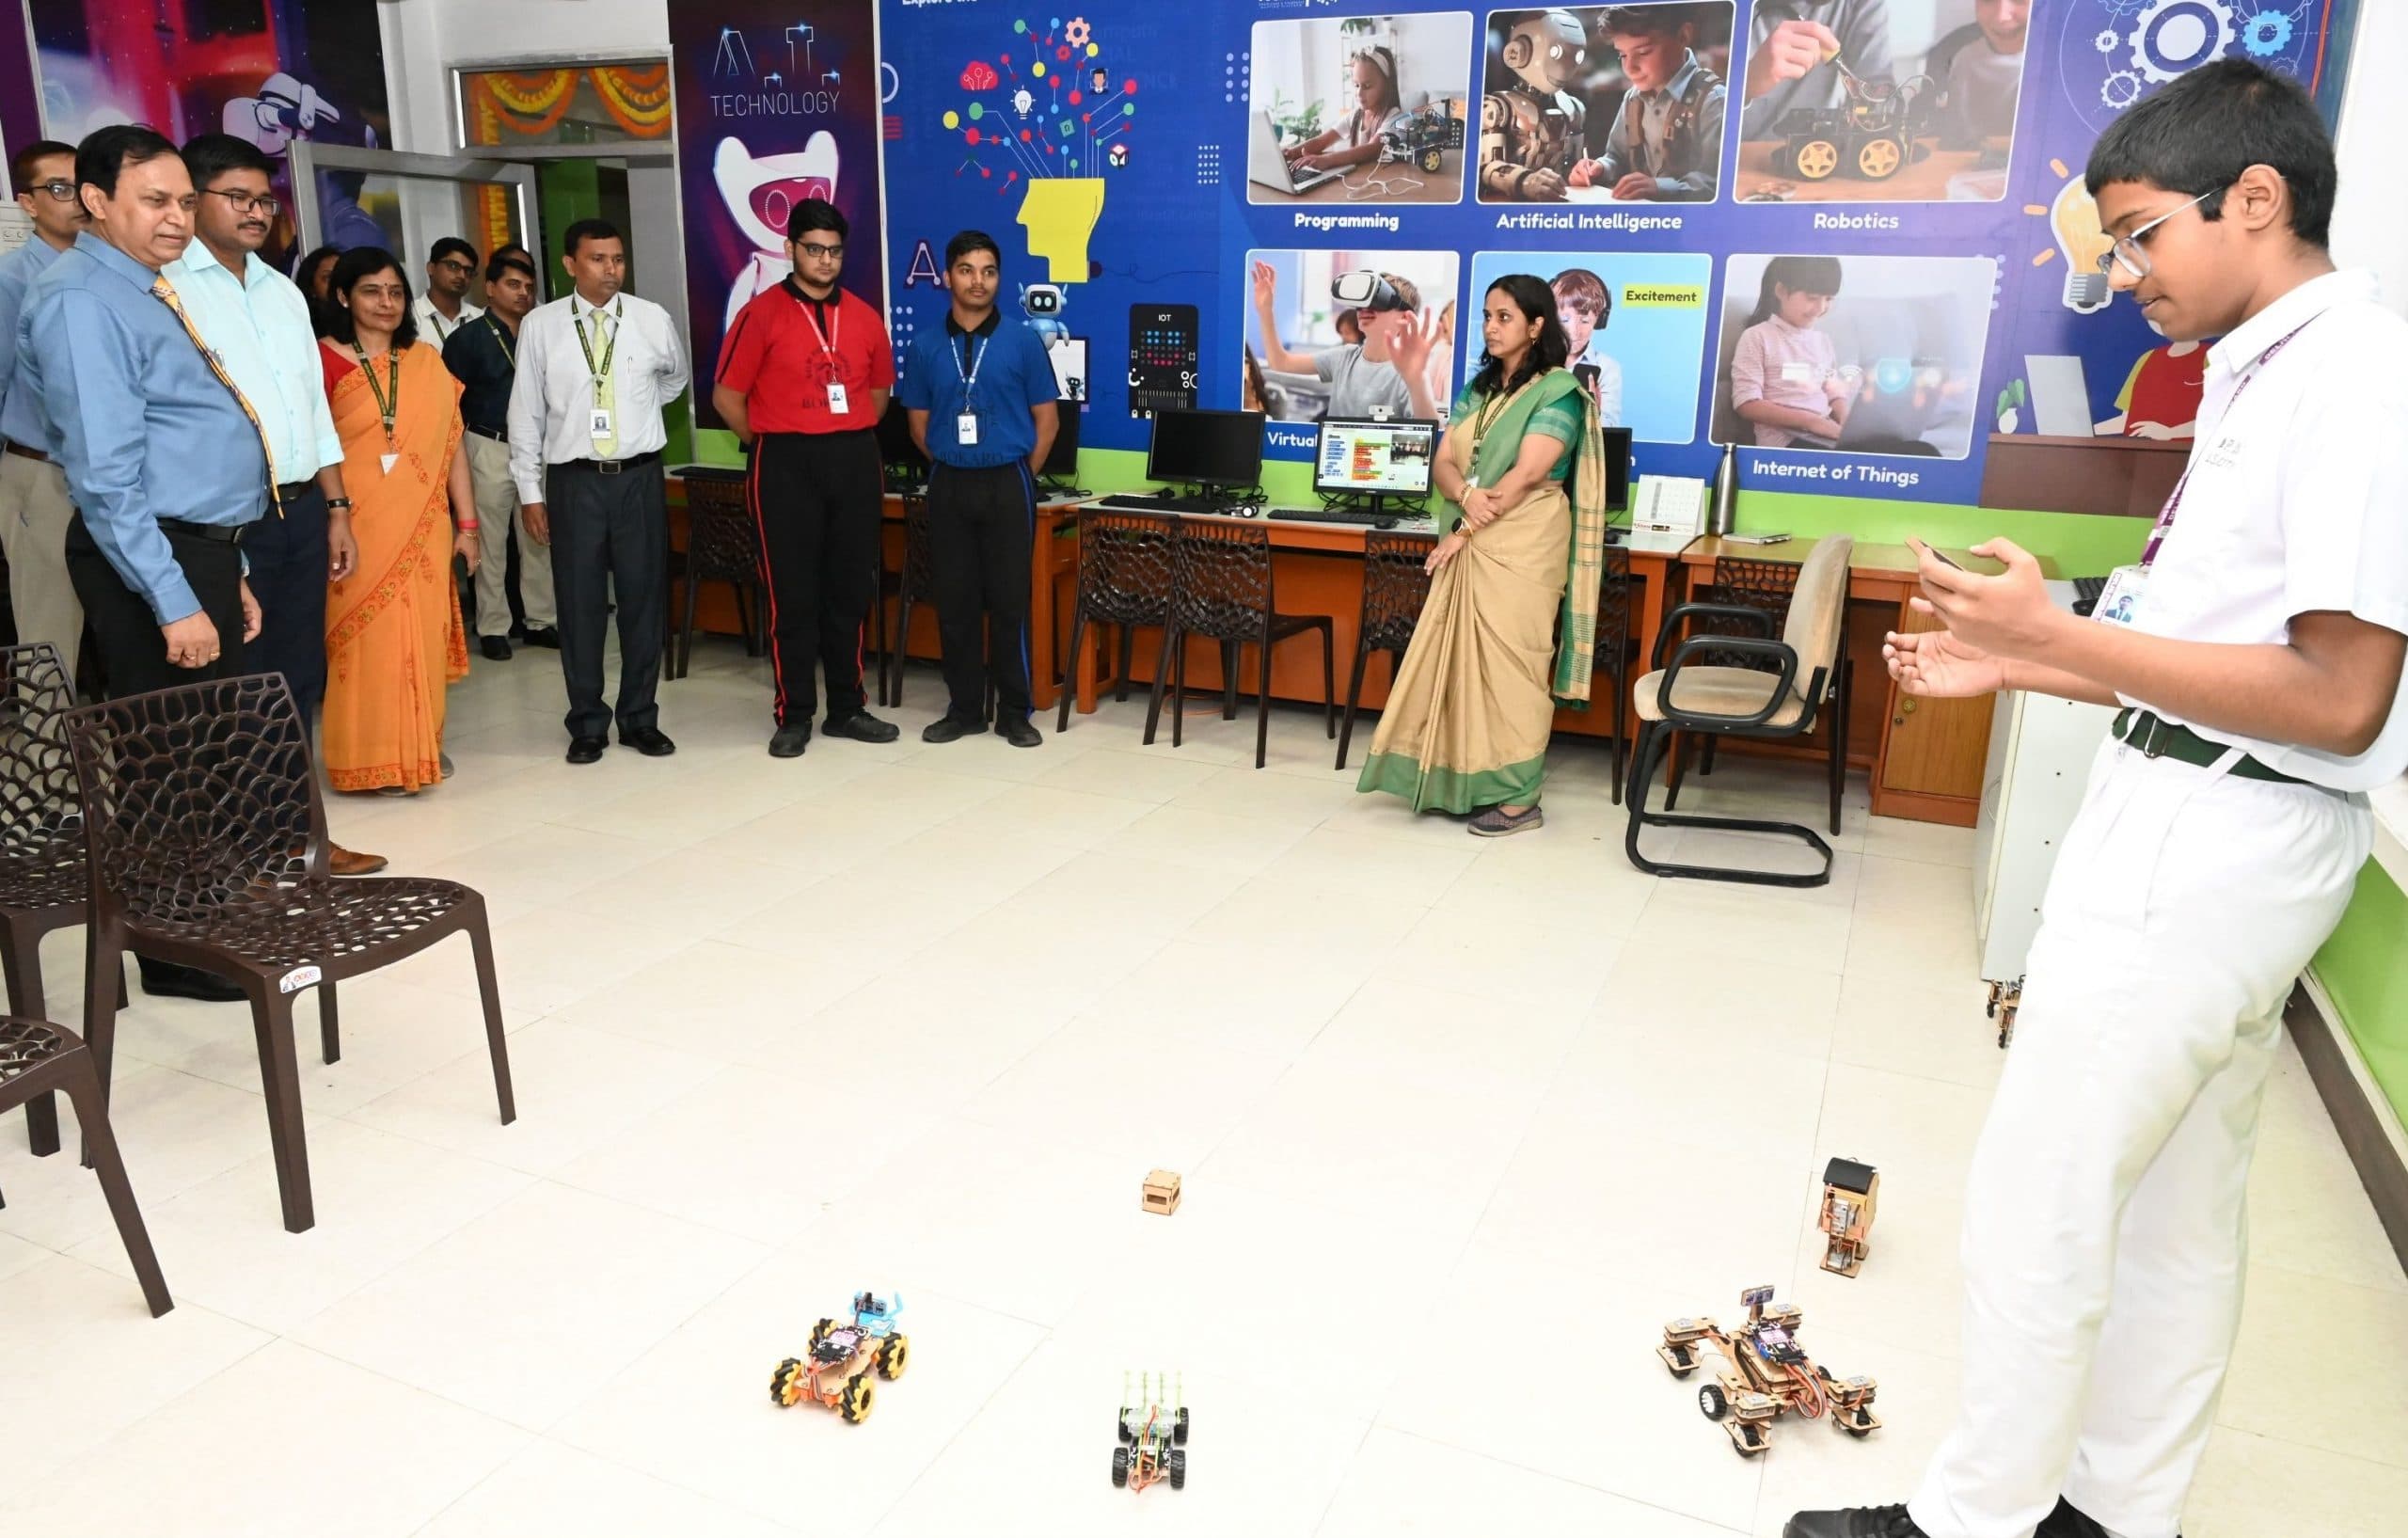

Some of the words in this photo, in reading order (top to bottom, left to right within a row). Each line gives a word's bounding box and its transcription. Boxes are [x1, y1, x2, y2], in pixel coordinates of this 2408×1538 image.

[710, 91, 840, 117] TECHNOLOGY
[1294, 213, 1400, 231] Programming
[1496, 213, 1575, 230] Artificial
[1578, 213, 1683, 232] Intelligence
[1814, 212, 1899, 229] Robotics
[1625, 290, 1698, 302] Excitement
[1158, 313, 1172, 322] IOT
[1267, 431, 1318, 448] Virtual
[1752, 459, 1828, 479] Internet
[1830, 464, 1853, 481] of
[1857, 465, 1920, 488] Things
